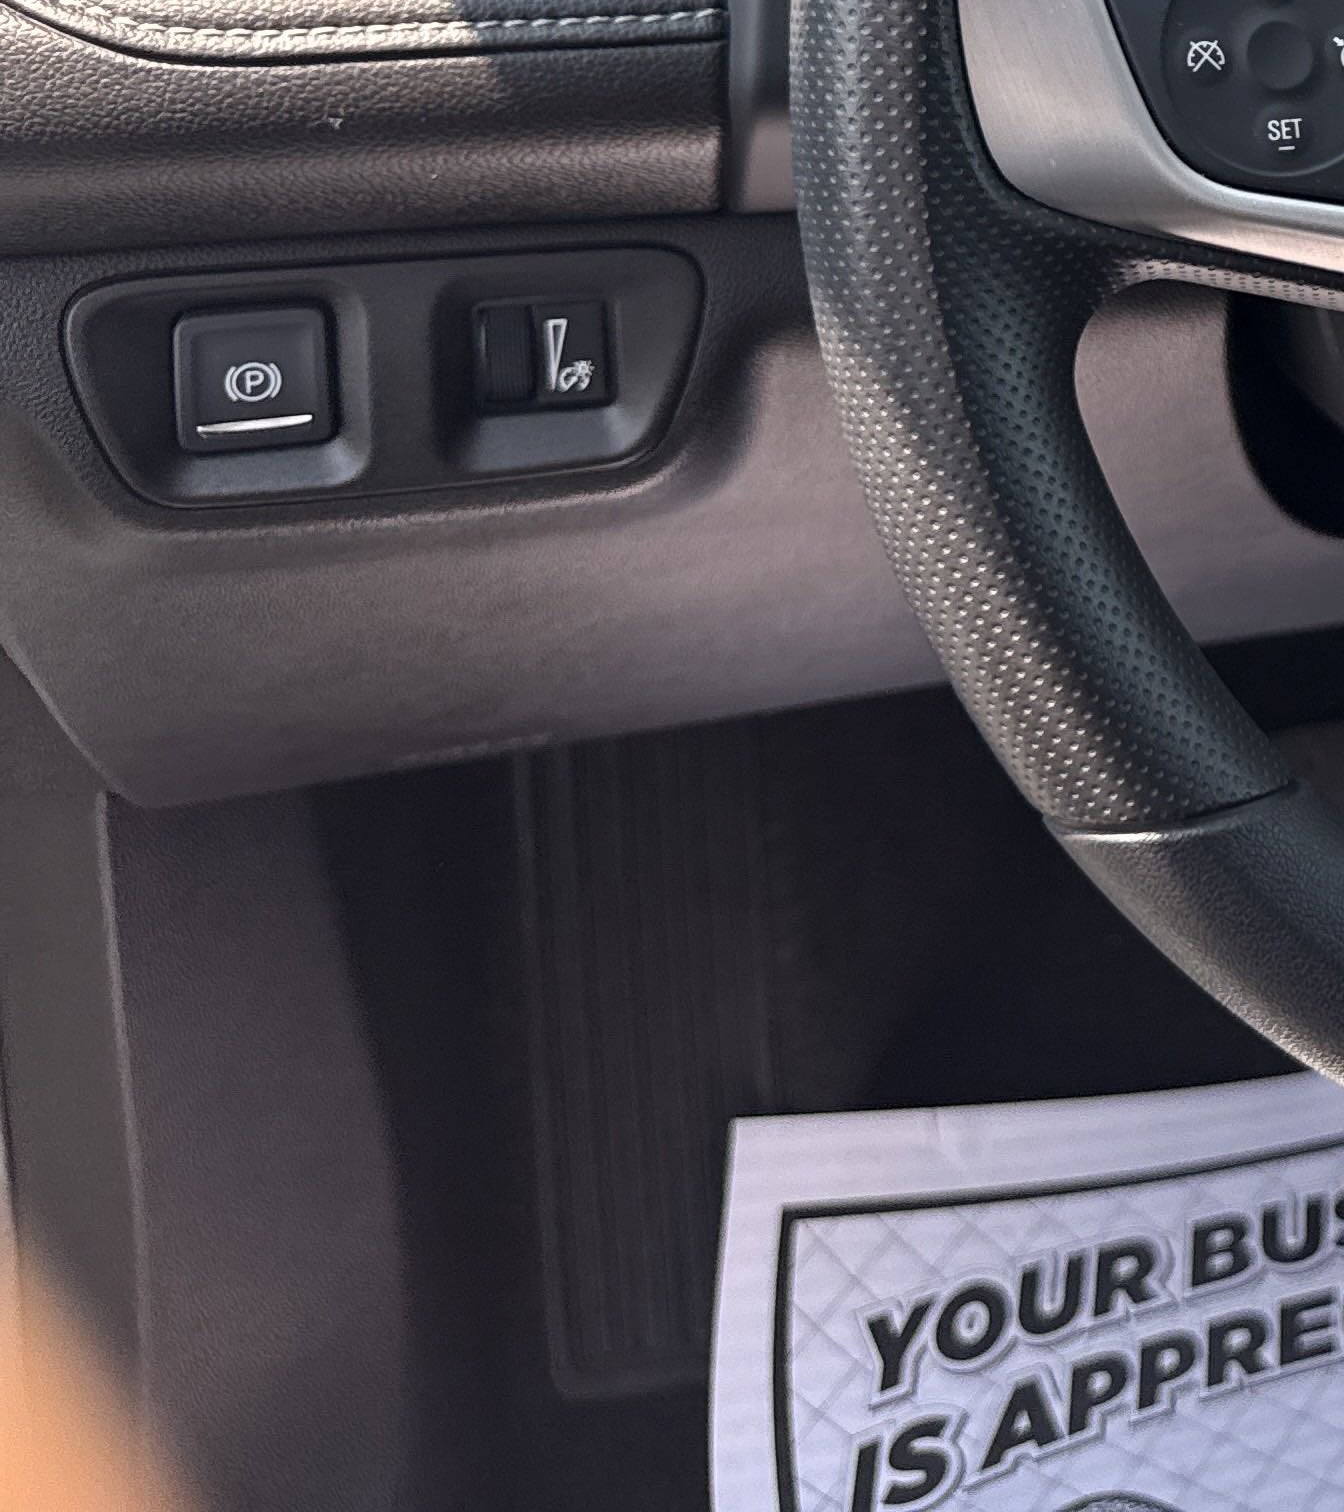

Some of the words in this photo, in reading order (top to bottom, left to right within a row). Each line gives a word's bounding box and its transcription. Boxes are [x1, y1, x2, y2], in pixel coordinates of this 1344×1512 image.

[1267, 117, 1303, 141] SET
[866, 1236, 1163, 1393] YOUR
[850, 1412, 952, 1512] IS
